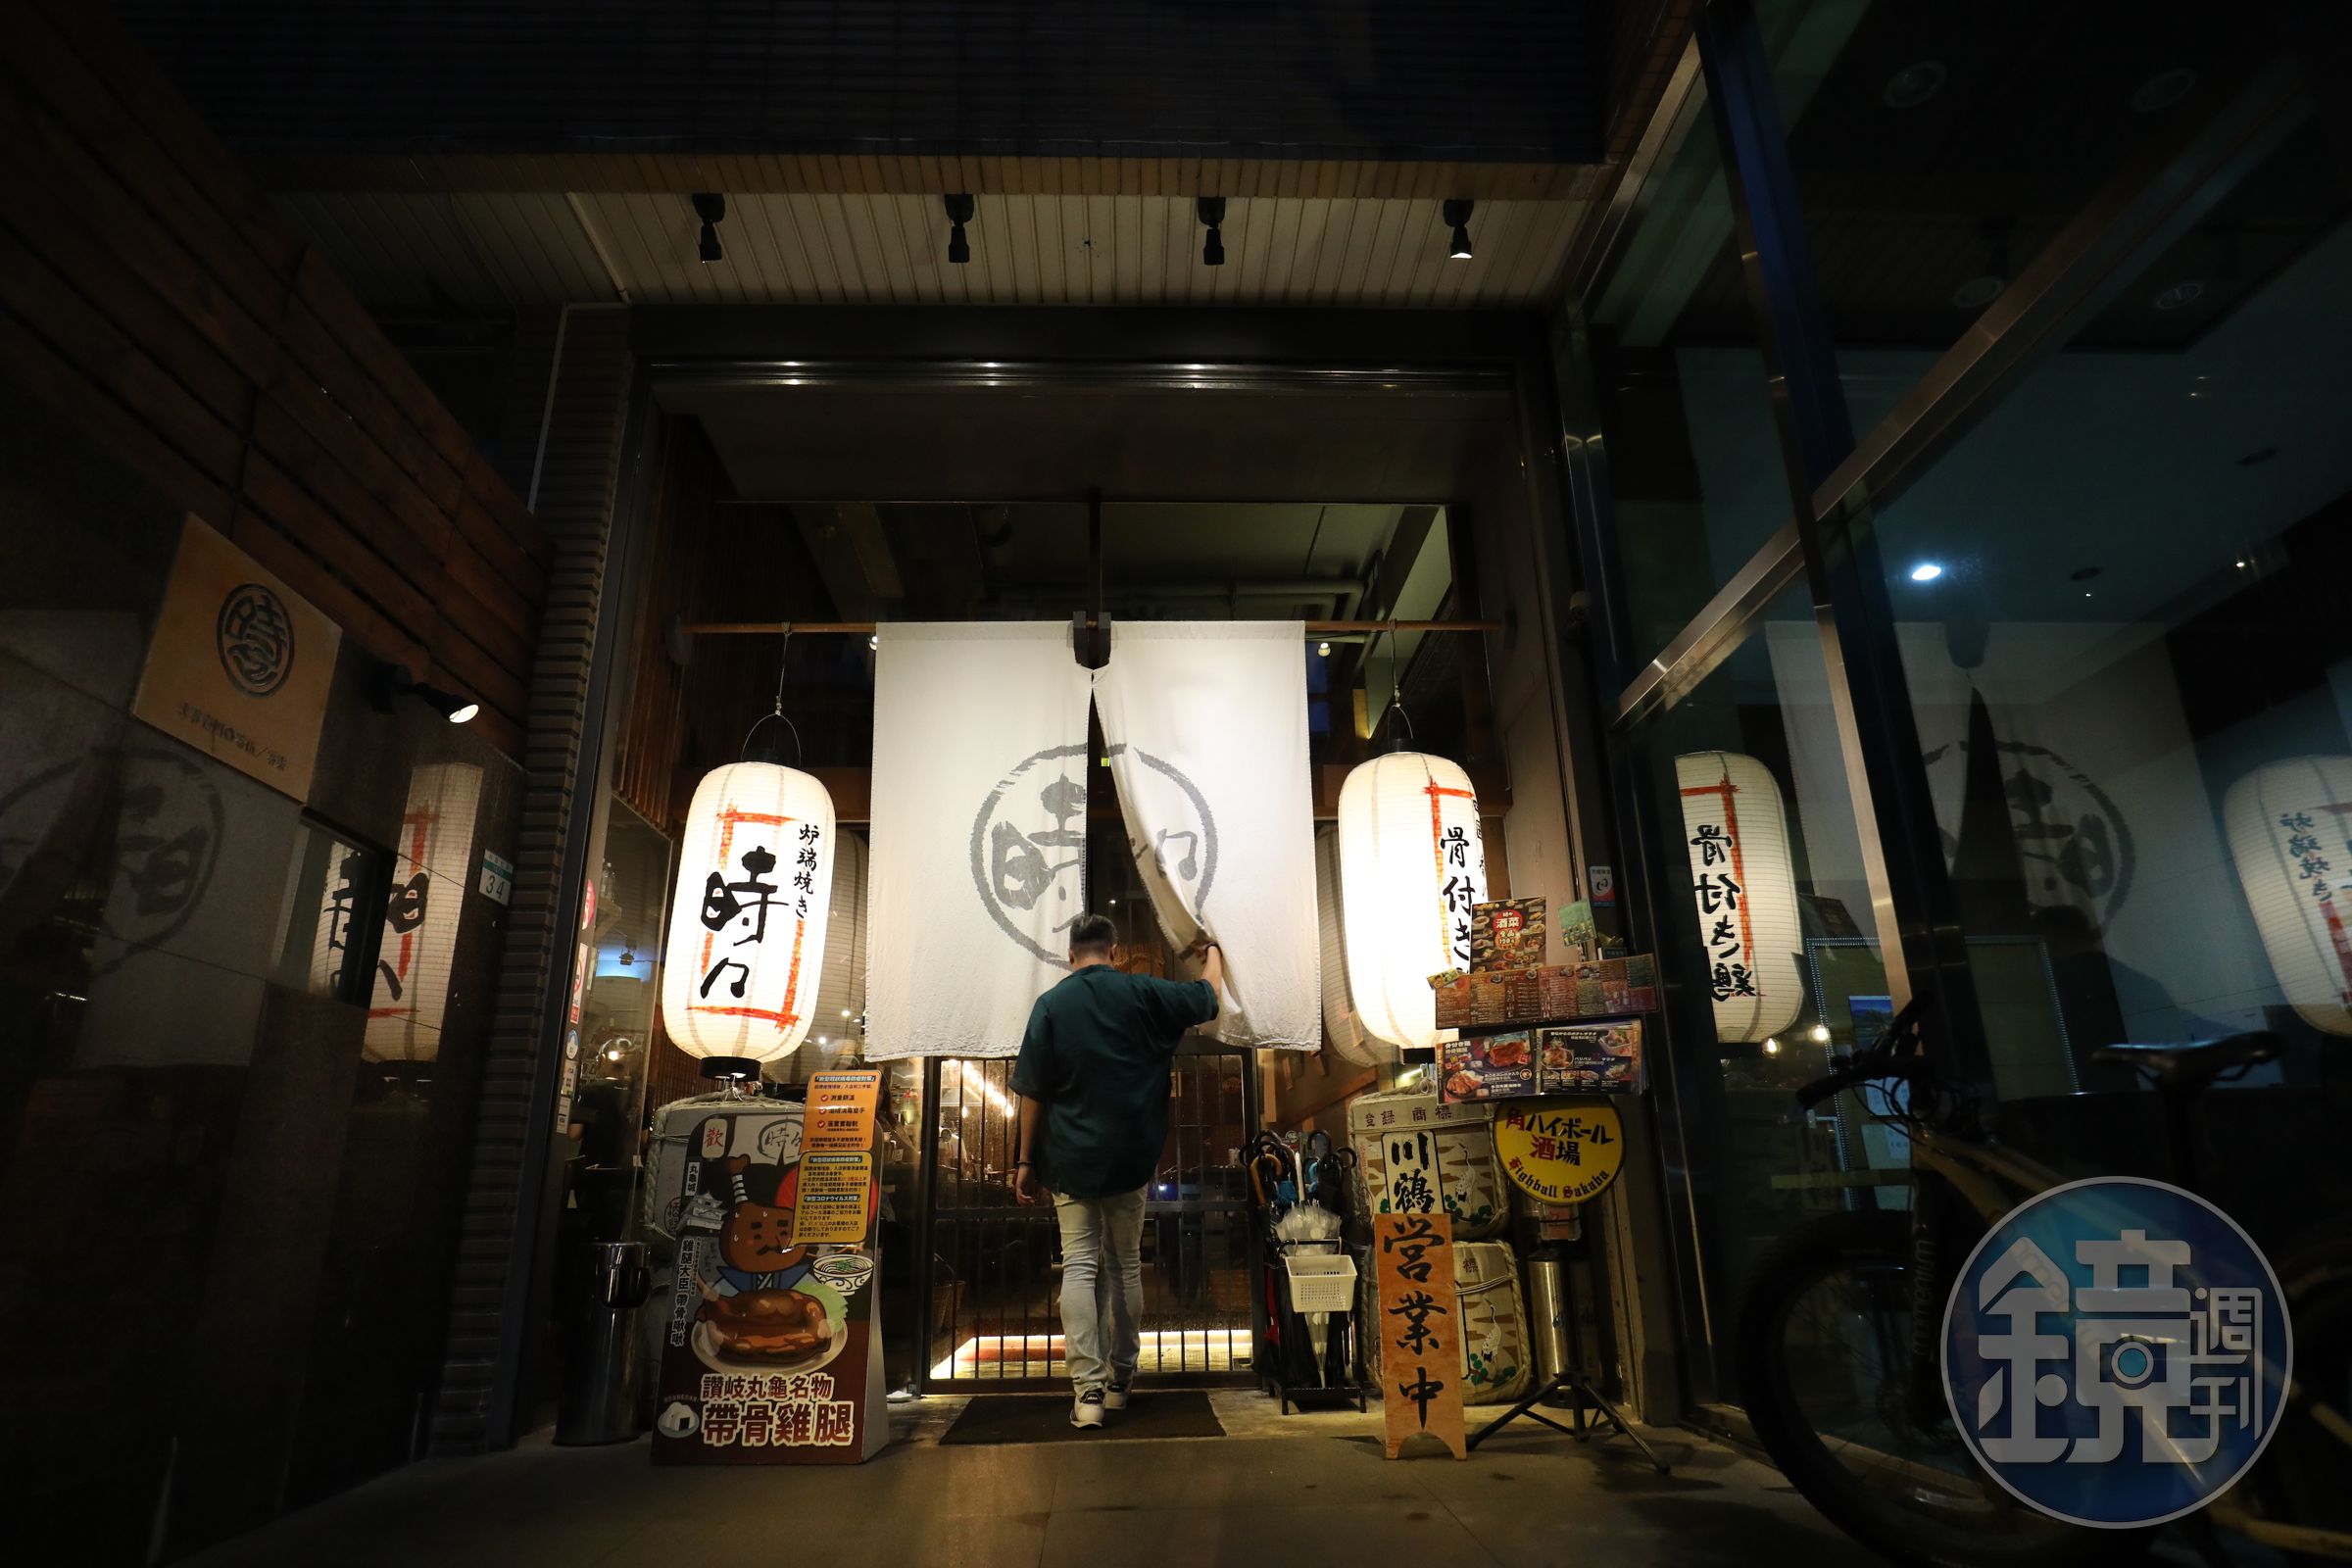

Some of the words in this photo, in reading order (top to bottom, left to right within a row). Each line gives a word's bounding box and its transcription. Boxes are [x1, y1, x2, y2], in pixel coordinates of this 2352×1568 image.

[793, 823, 819, 918] 炉端焼き
[1440, 826, 1475, 974] 骨付き
[706, 1127, 724, 1148] 歡
[1505, 1106, 1615, 1145] 角ハイボール
[1530, 1134, 1581, 1166] 酒場
[1507, 1155, 1557, 1199] Highball
[1562, 1170, 1610, 1200] Sakaba
[702, 1374, 833, 1399] 讚岐丸龜名物
[703, 1401, 853, 1446] 帶骨雞腿
